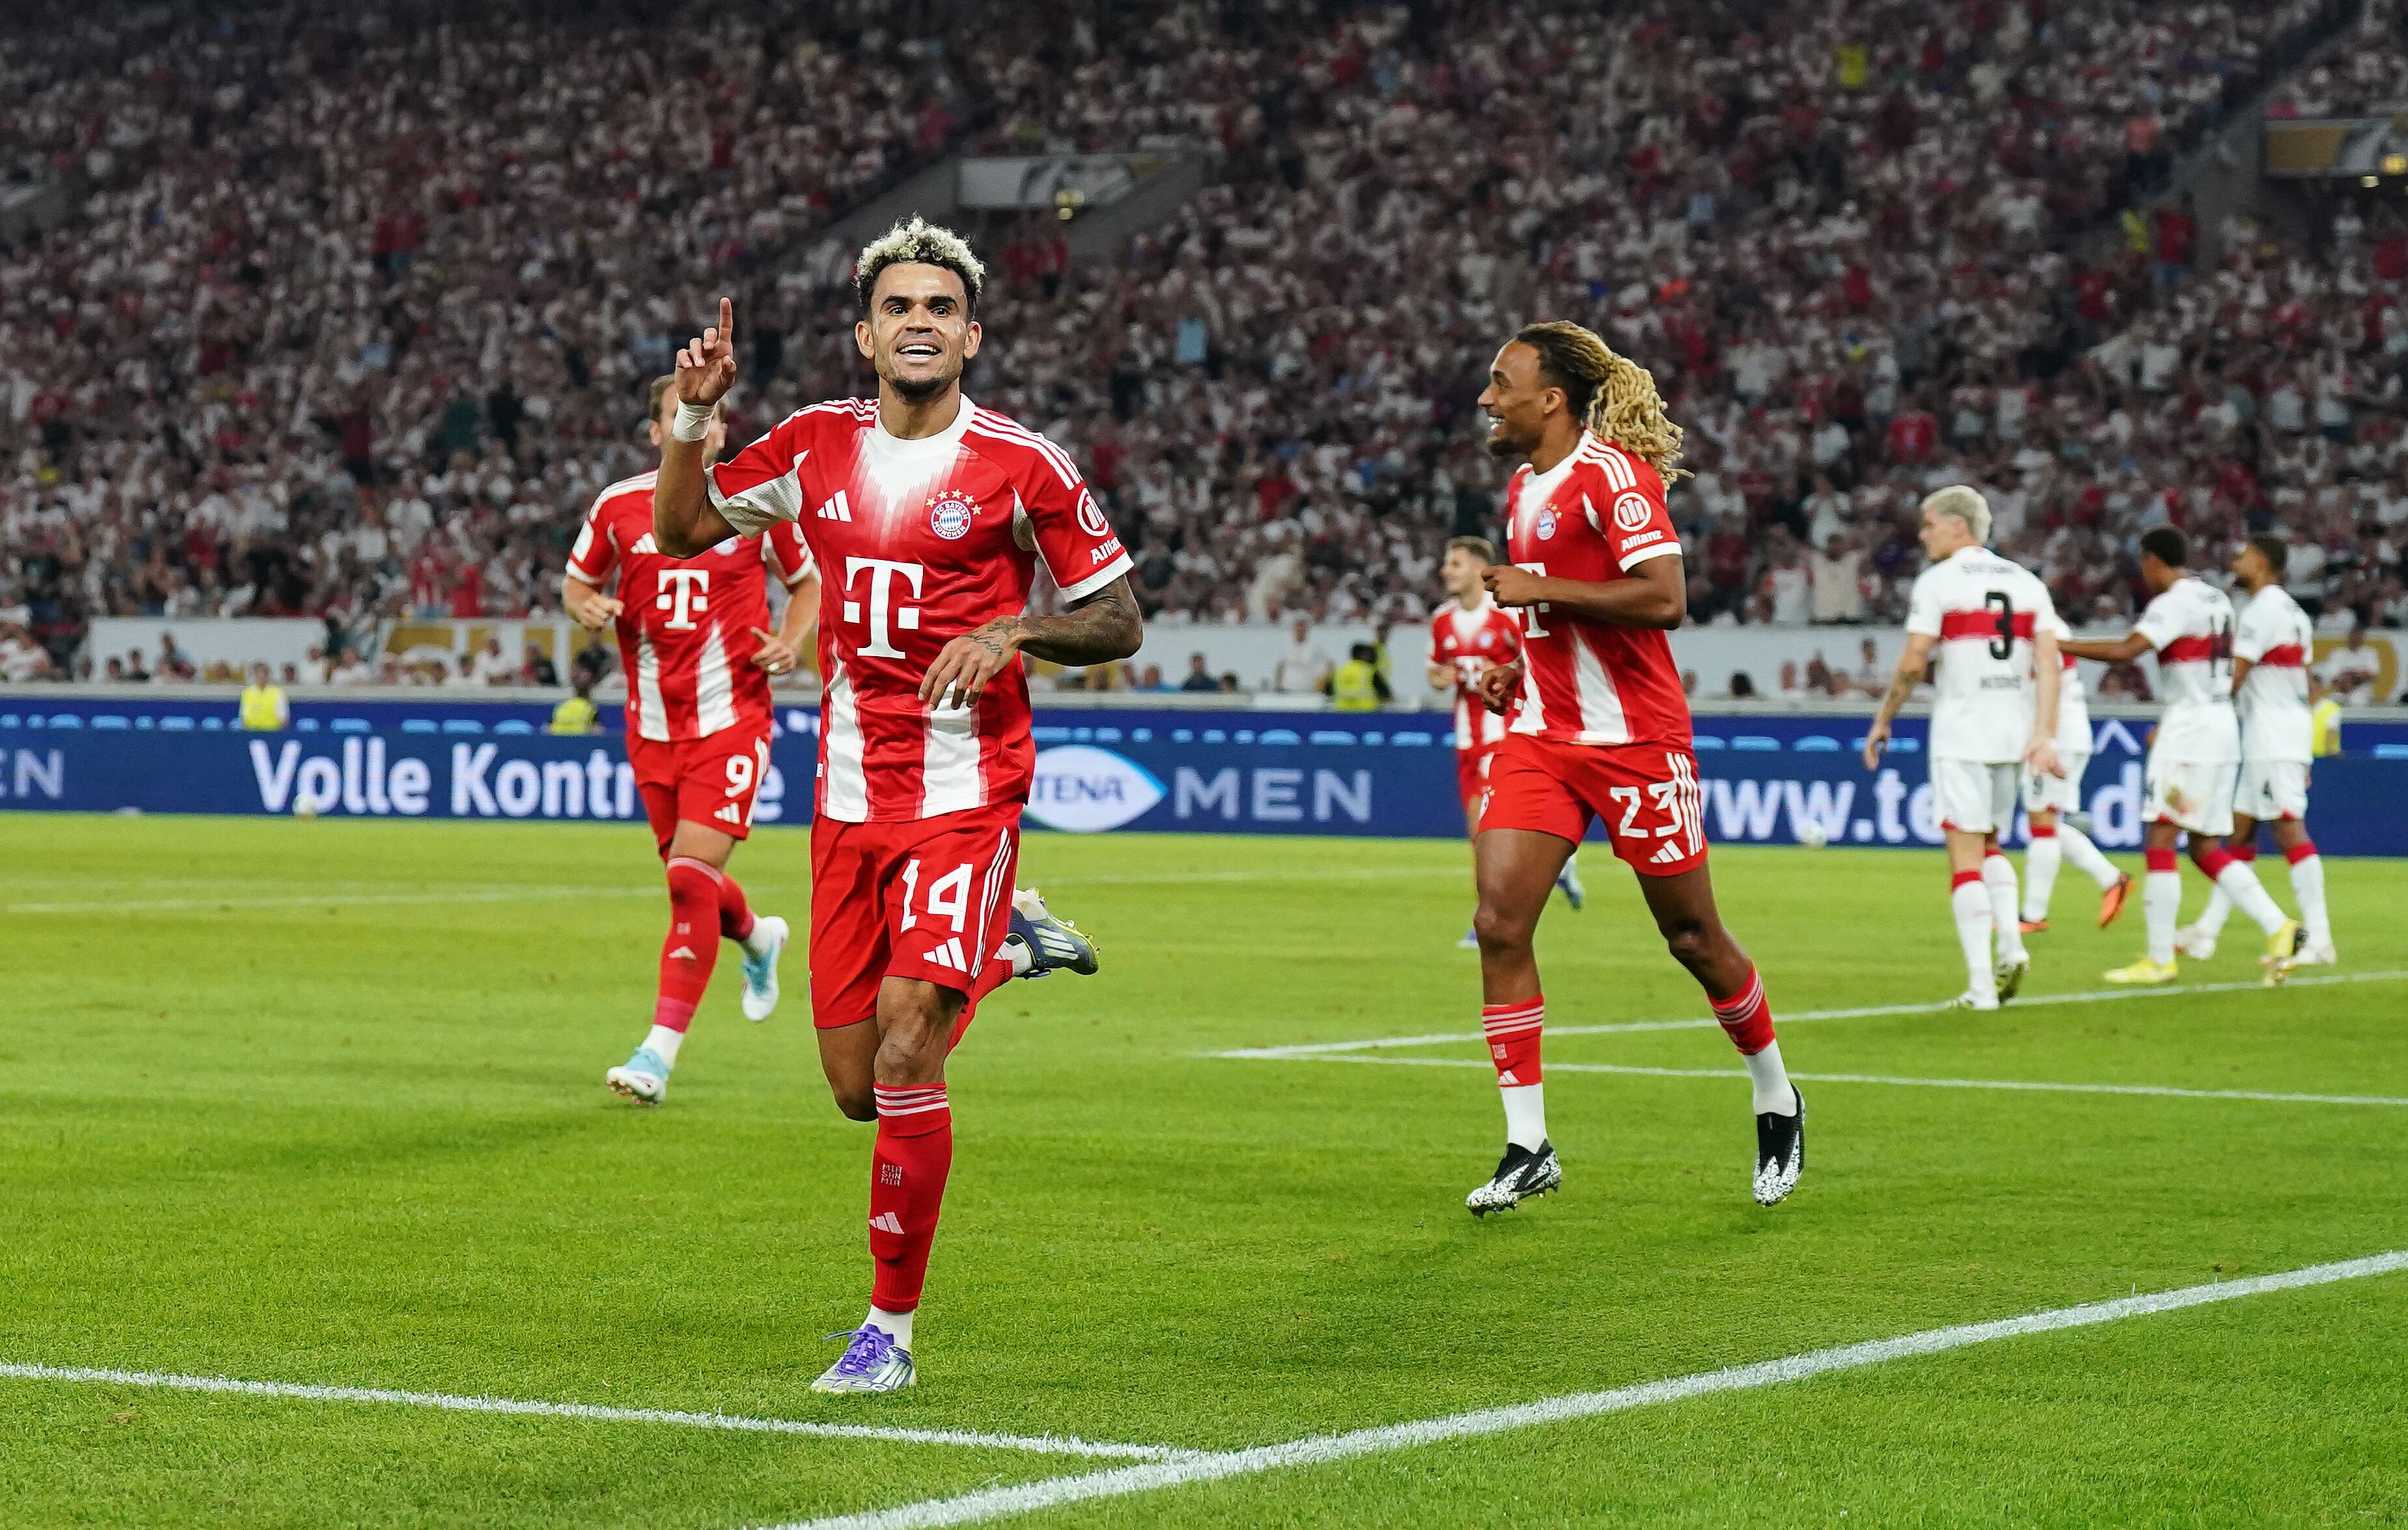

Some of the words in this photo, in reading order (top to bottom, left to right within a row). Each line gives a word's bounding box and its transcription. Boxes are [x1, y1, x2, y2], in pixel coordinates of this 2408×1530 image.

[945, 503, 968, 520] BAYERN
[1621, 530, 1664, 552] Allianz
[656, 569, 710, 630] T
[843, 556, 924, 660] T
[1985, 591, 2013, 660] 3
[248, 736, 431, 815] Volle
[725, 755, 753, 798] 9
[1174, 767, 1372, 822] MEN
[1610, 780, 1683, 838] 23
[901, 859, 973, 933] 14
[880, 1176, 900, 1187] MIA
[881, 1170, 901, 1180] SAN
[882, 1163, 902, 1173] MIA
